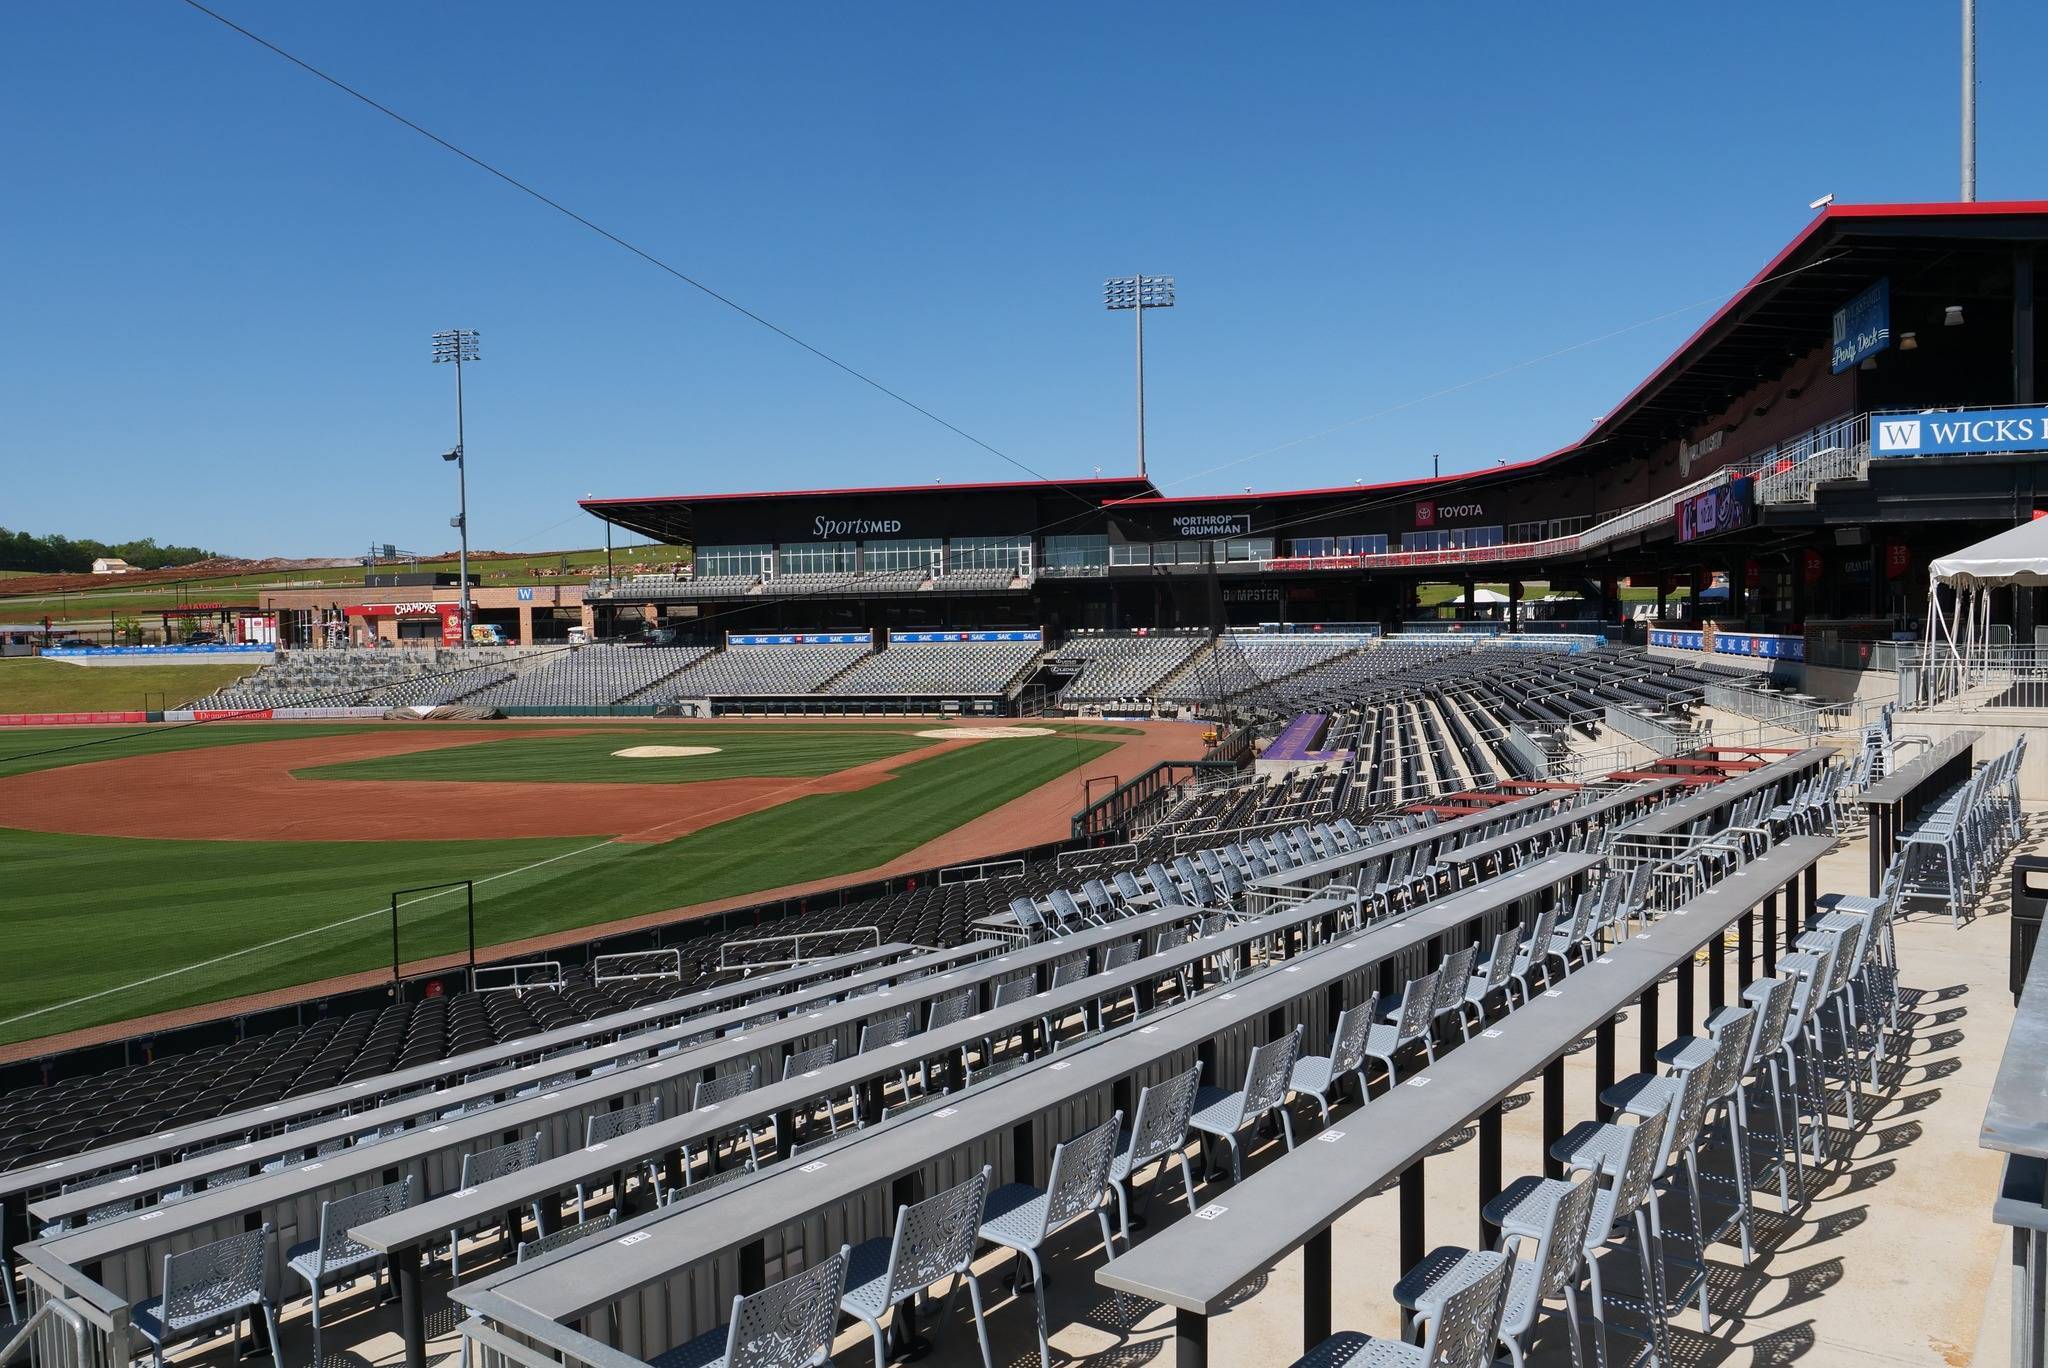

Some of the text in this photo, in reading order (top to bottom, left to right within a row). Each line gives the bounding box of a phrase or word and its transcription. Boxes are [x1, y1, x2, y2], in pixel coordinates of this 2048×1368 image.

[1835, 327, 1877, 366] Party Deck
[1885, 424, 1916, 445] W
[1930, 418, 2034, 445] WICKS
[1437, 504, 1483, 519] TOYOTA
[1173, 515, 1232, 526] NORTHROP
[813, 515, 902, 539] SportsMED
[1181, 525, 1241, 536] GRUMMAN
[1893, 546, 1905, 555] 12
[1893, 555, 1905, 565] 13
[519, 588, 532, 600] W
[1223, 588, 1280, 601] DMPSTER
